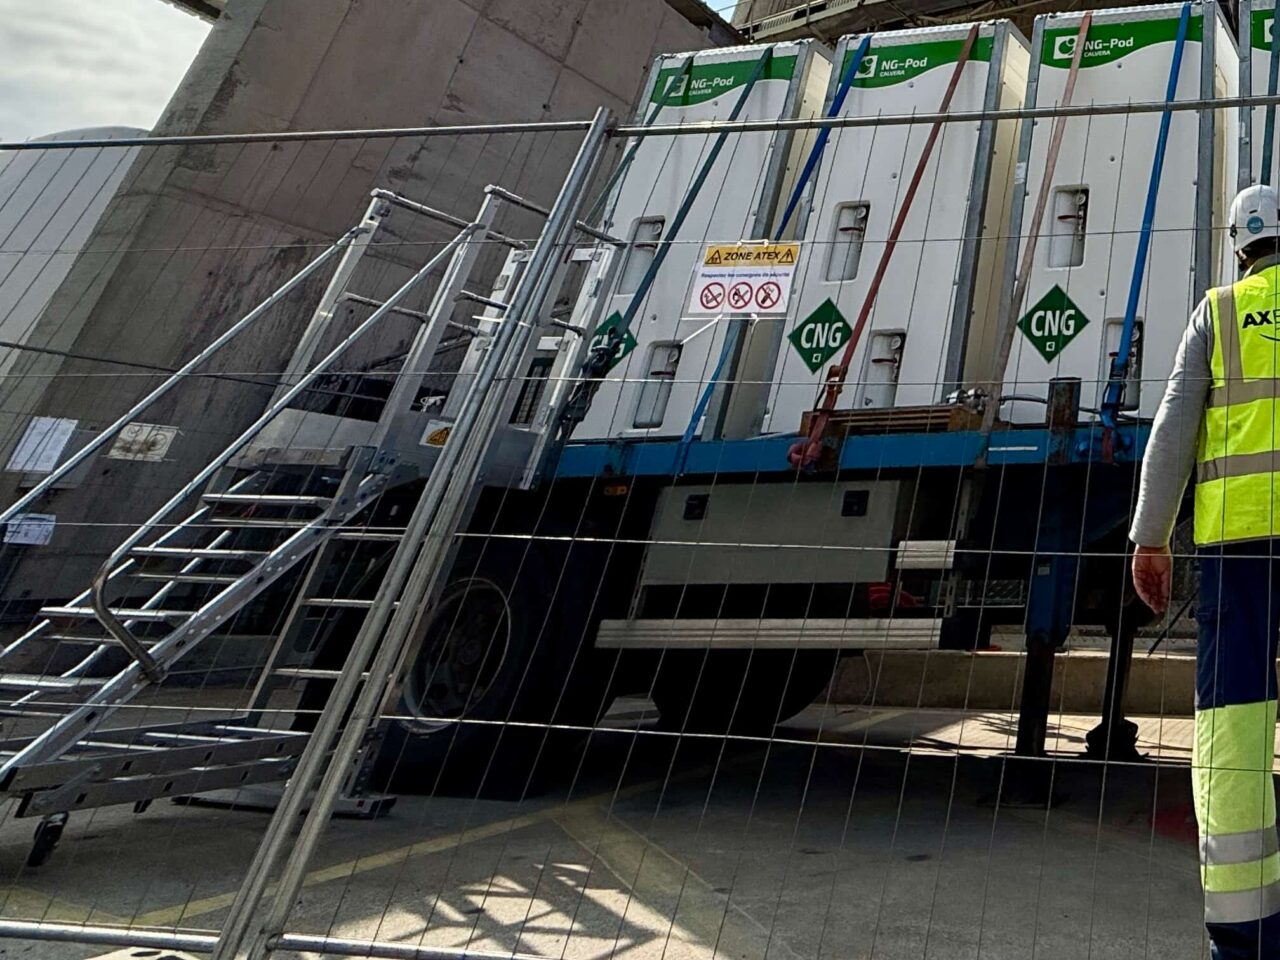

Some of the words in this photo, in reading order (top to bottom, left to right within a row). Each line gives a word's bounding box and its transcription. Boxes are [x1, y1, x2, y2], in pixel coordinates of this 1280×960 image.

[1084, 37, 1134, 50] NG-Pod
[1083, 49, 1111, 58] CALVERA
[881, 57, 928, 70] NG-Pod
[690, 76, 735, 89] NG-Pod
[724, 252, 753, 261] ZONE
[753, 251, 781, 260] ATEX
[1031, 309, 1076, 337] CNG
[800, 322, 843, 349] CNG
